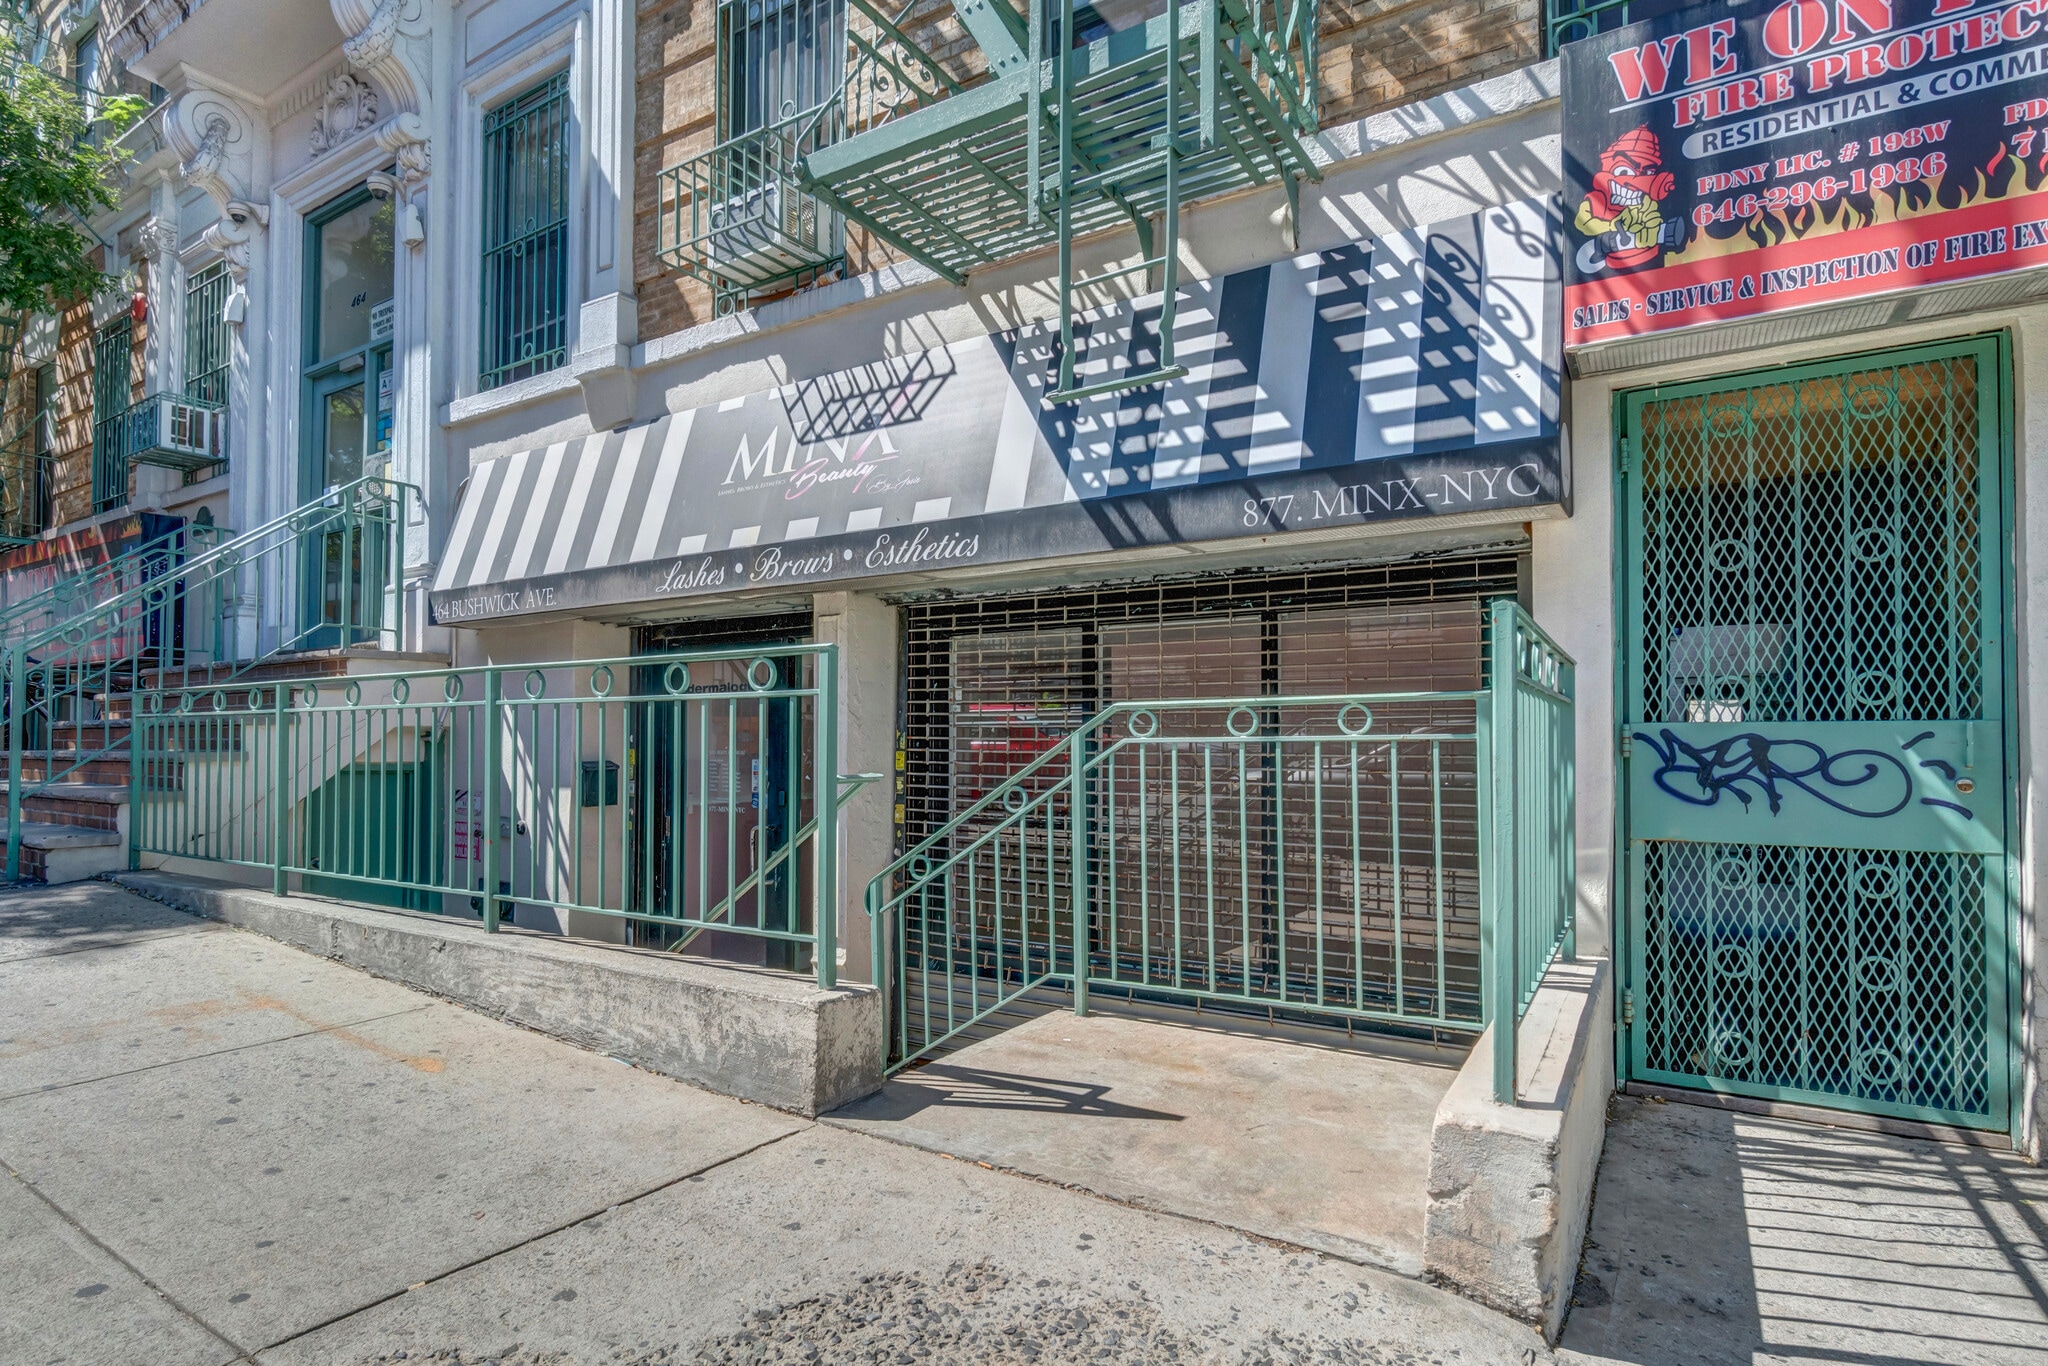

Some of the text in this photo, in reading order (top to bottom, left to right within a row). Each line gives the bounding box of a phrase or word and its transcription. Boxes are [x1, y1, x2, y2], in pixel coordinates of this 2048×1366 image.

[1608, 17, 1737, 102] WE
[1673, 0, 2048, 129] FIRE PROTEC
[1701, 90, 1889, 154] RESIDENTIAL
[1897, 81, 1921, 105] &
[2003, 98, 2048, 126] FD
[2011, 129, 2037, 158] 7
[1692, 151, 1947, 227] 646-296-1986
[1697, 120, 1951, 195] FDNY LIC. # 198W
[351, 291, 366, 307] 464
[1572, 298, 1632, 330] SALES
[1645, 277, 1734, 317] SERVICE
[1738, 274, 1756, 299] &
[1760, 246, 1899, 296] INSPECTION
[1905, 240, 1938, 269] OF
[1944, 227, 2007, 262] FIRE
[2013, 219, 2048, 250] EX
[785, 457, 885, 500] Beauty
[1311, 463, 1540, 520] MINX-NYC
[655, 527, 979, 593] Lashes Brows Esthetics
[432, 587, 557, 620] 464 BUSHWICK AVE.
